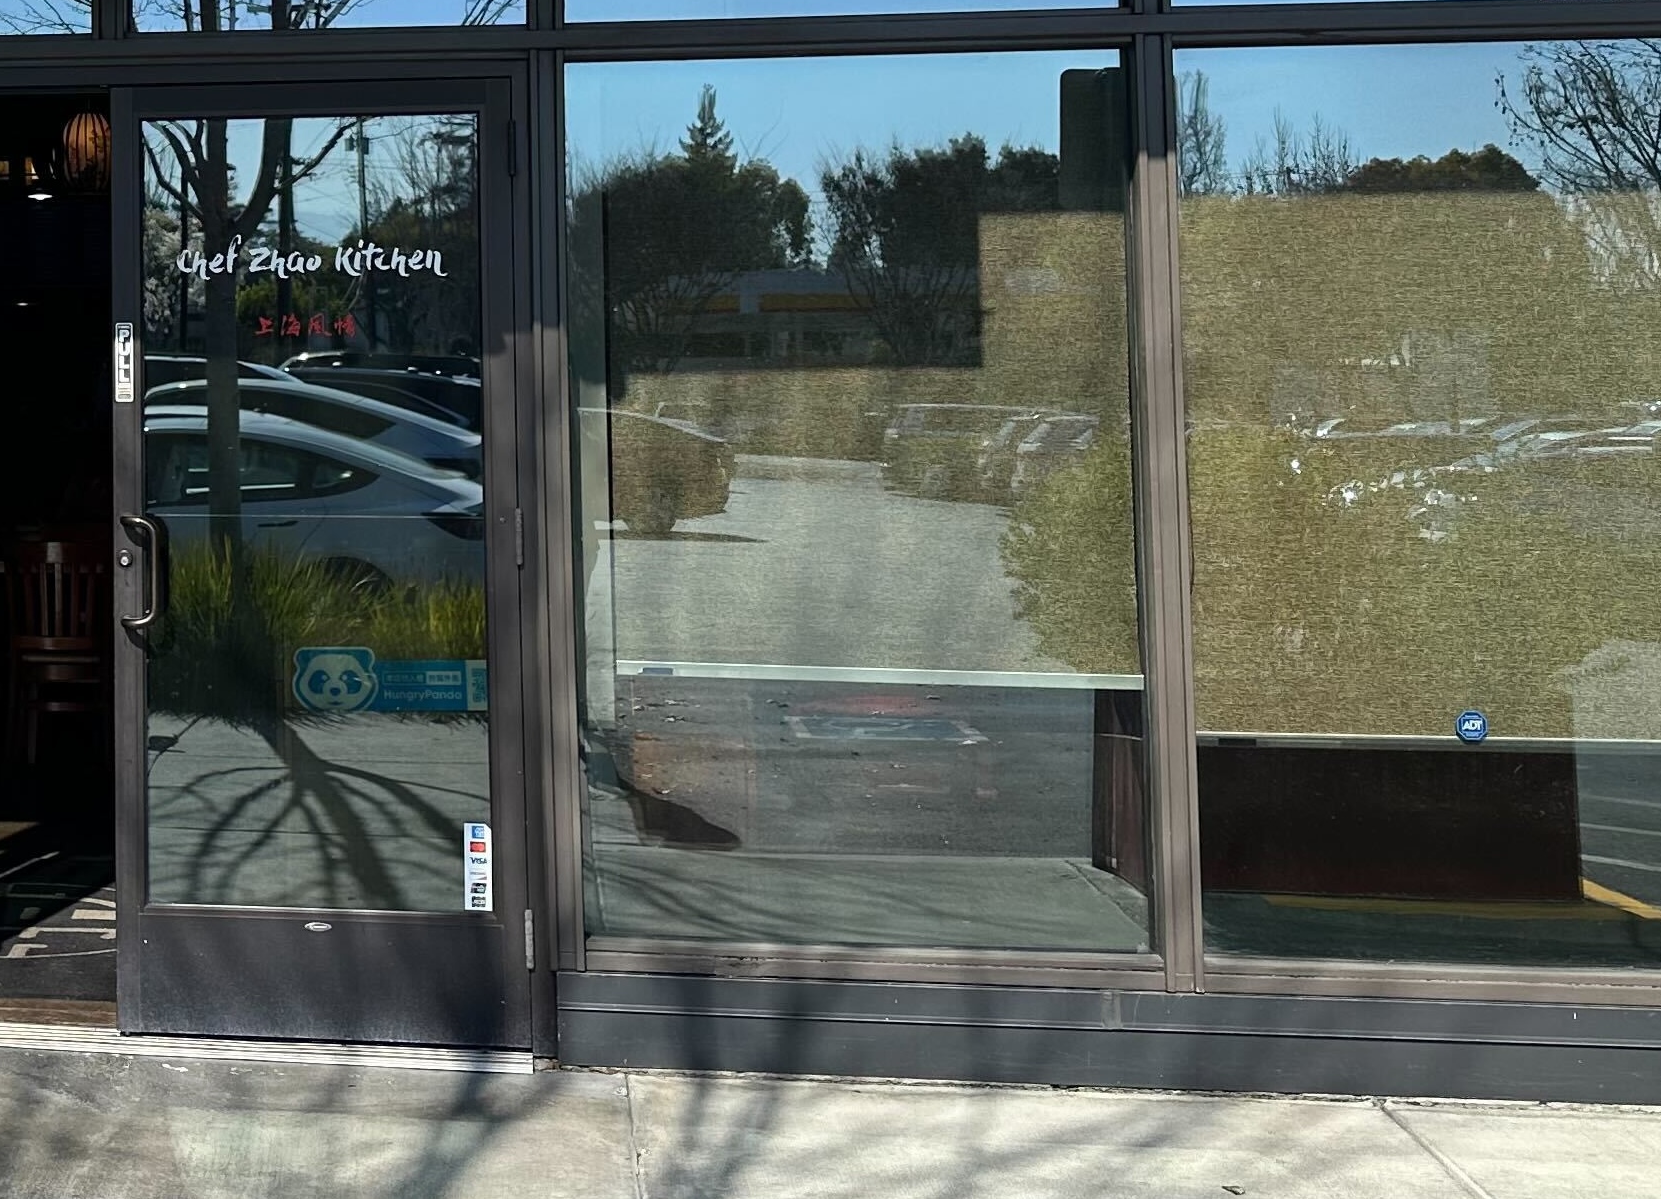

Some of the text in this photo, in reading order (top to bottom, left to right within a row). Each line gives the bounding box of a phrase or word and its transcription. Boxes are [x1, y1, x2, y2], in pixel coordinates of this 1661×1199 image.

[176, 234, 448, 280] Chef Zhao Kitchen
[118, 329, 131, 383] PULL
[383, 689, 463, 701] HungryPanda
[1462, 719, 1483, 732] ADT
